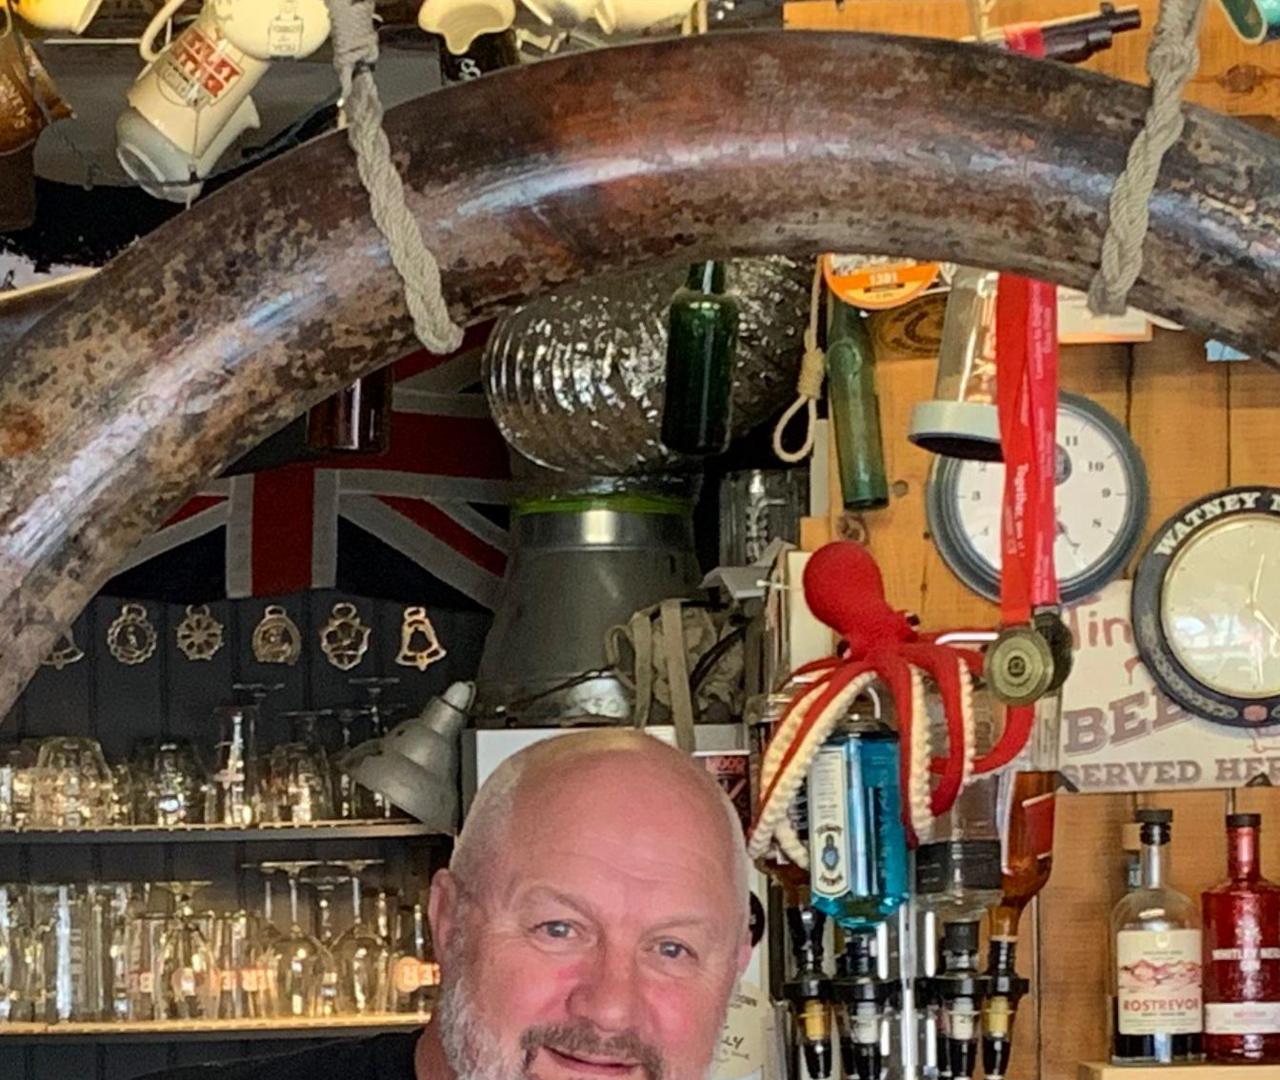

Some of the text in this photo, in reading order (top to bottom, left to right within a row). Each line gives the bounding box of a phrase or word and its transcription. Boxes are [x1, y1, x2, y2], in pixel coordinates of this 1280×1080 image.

[1087, 461, 1104, 473] 10
[1153, 490, 1261, 558] WATNEY
[1062, 760, 1202, 789] SERVED
